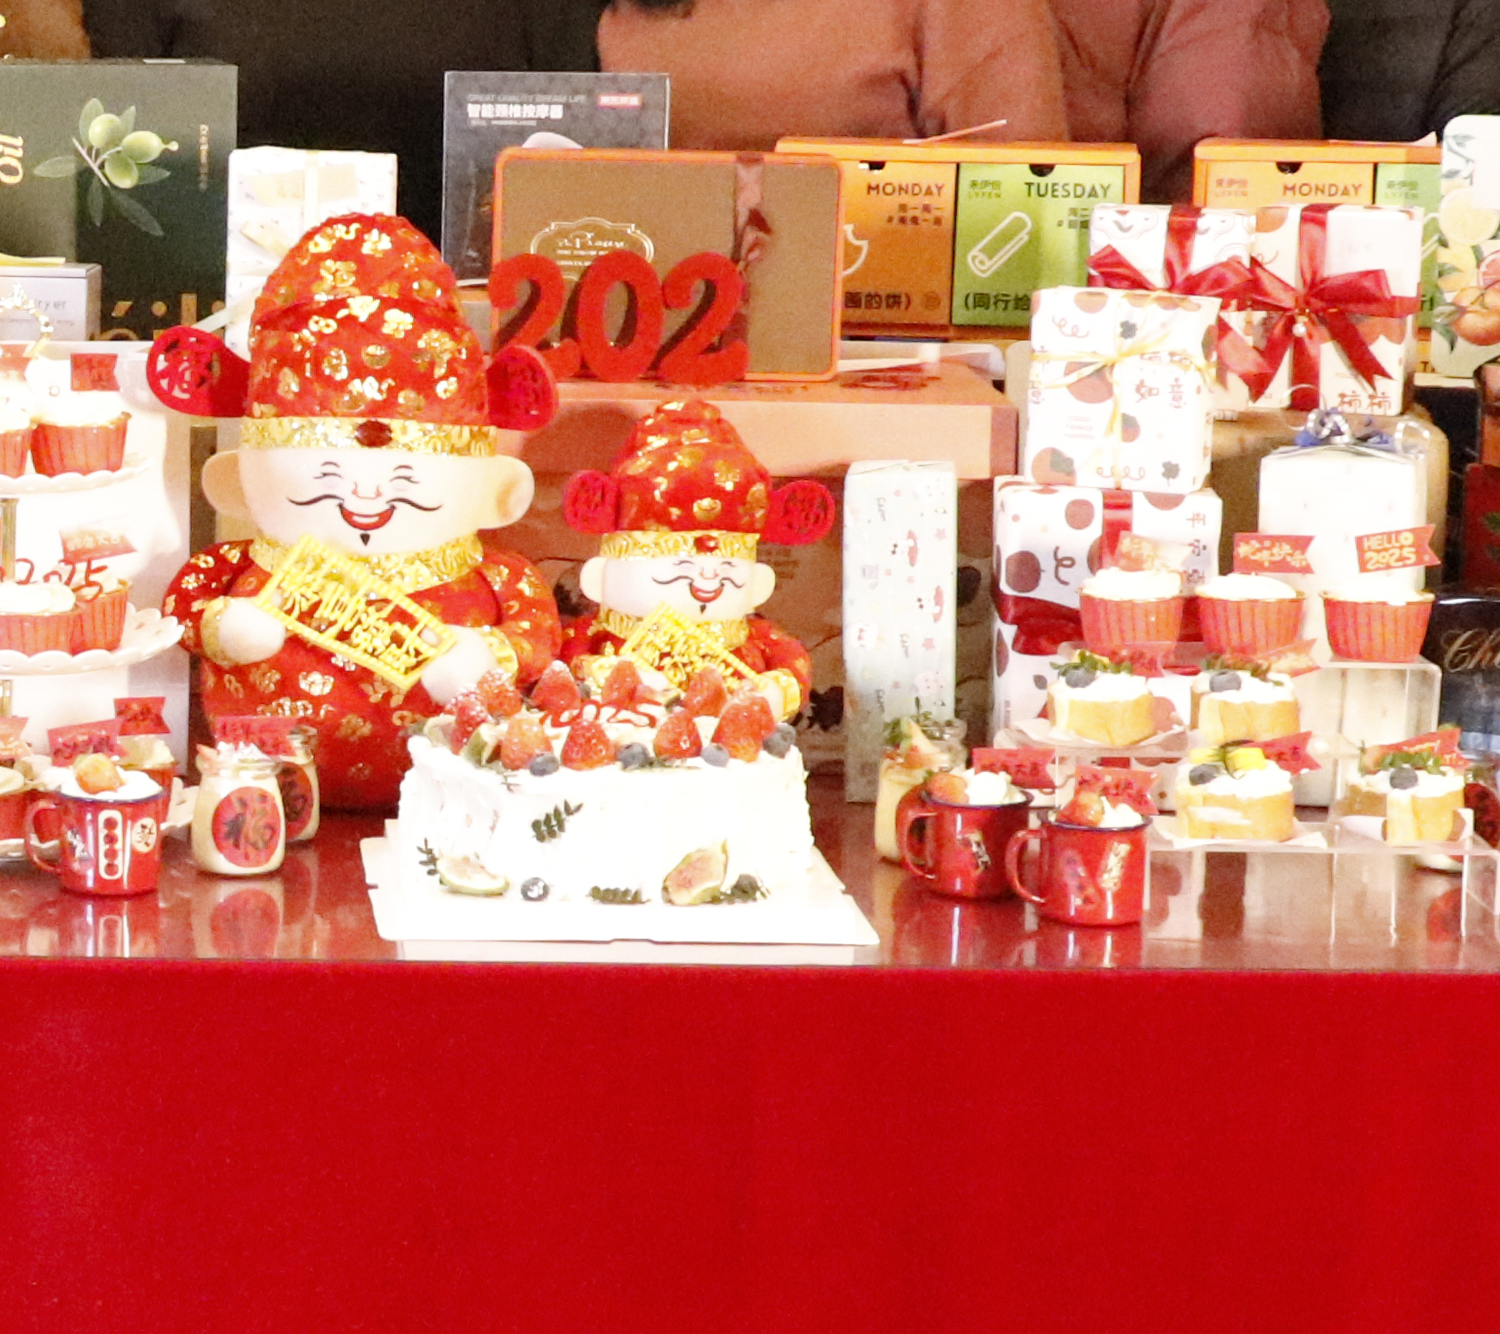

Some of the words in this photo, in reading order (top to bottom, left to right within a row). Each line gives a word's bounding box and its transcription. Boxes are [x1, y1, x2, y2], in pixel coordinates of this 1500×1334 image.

[866, 182, 945, 197] MONDAY
[1024, 181, 1113, 199] TUESDAY
[1282, 182, 1364, 198] MONDAY
[488, 250, 750, 384] 202
[1362, 532, 1414, 549] HELLO
[1365, 547, 1417, 569] 2025
